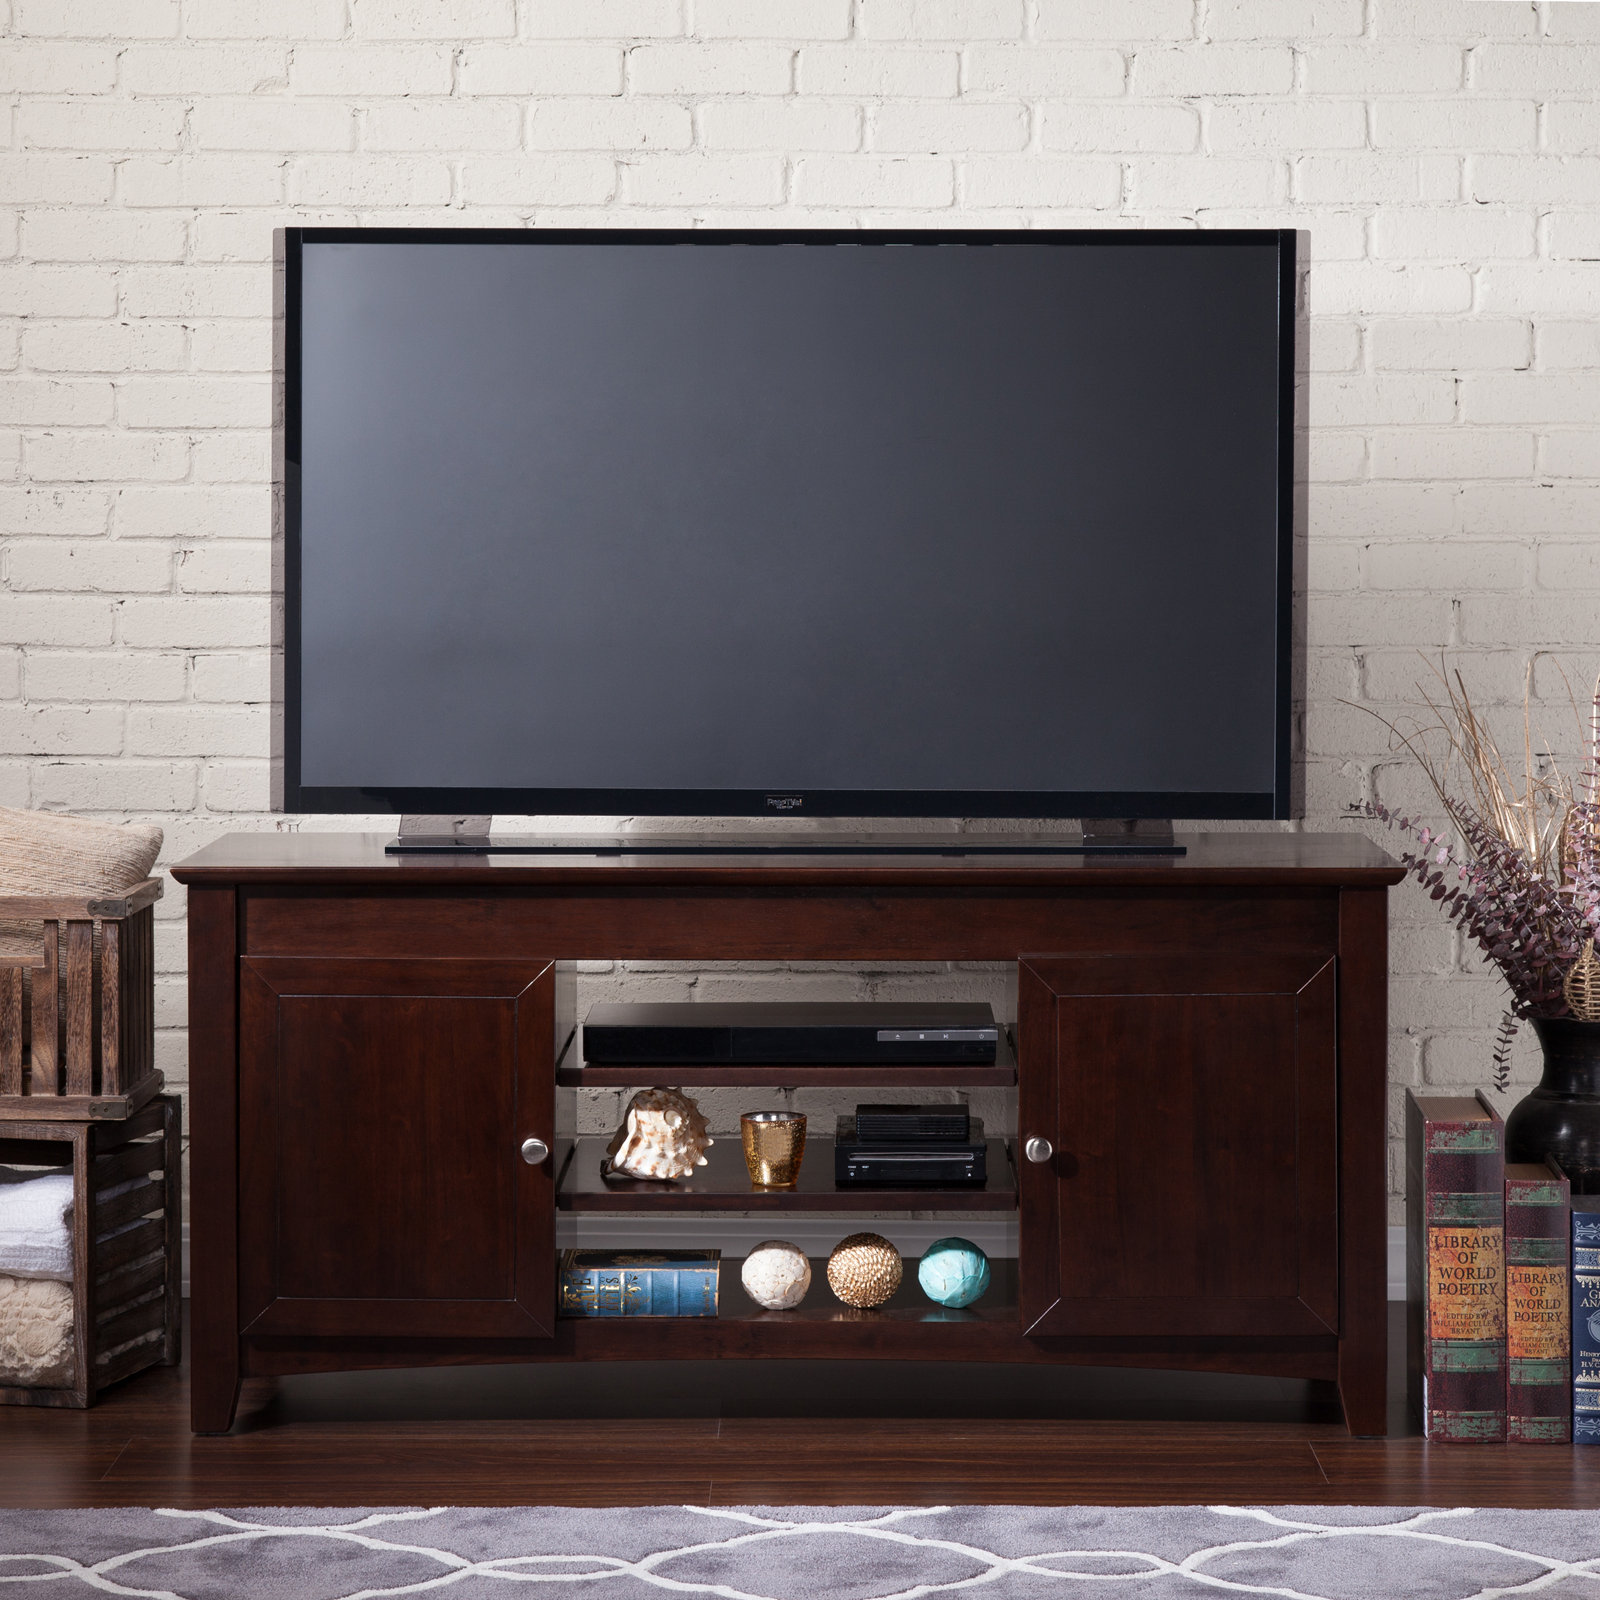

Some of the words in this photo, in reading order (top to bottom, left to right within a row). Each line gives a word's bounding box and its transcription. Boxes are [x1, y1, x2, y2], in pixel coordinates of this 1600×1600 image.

[1435, 1235, 1500, 1249] LIBRARY
[1457, 1251, 1479, 1265] OF
[1438, 1267, 1497, 1280] WORLD
[1511, 1273, 1565, 1284] LIBRARY
[606, 1277, 620, 1310] CITIES
[1438, 1282, 1499, 1296] POETRY
[1529, 1286, 1547, 1297] OF
[1514, 1298, 1562, 1310] WORLD
[1446, 1312, 1474, 1320] EDITED
[1476, 1312, 1487, 1321] BY
[1513, 1311, 1563, 1323] POETRY
[1450, 1327, 1481, 1335] BRYANT
